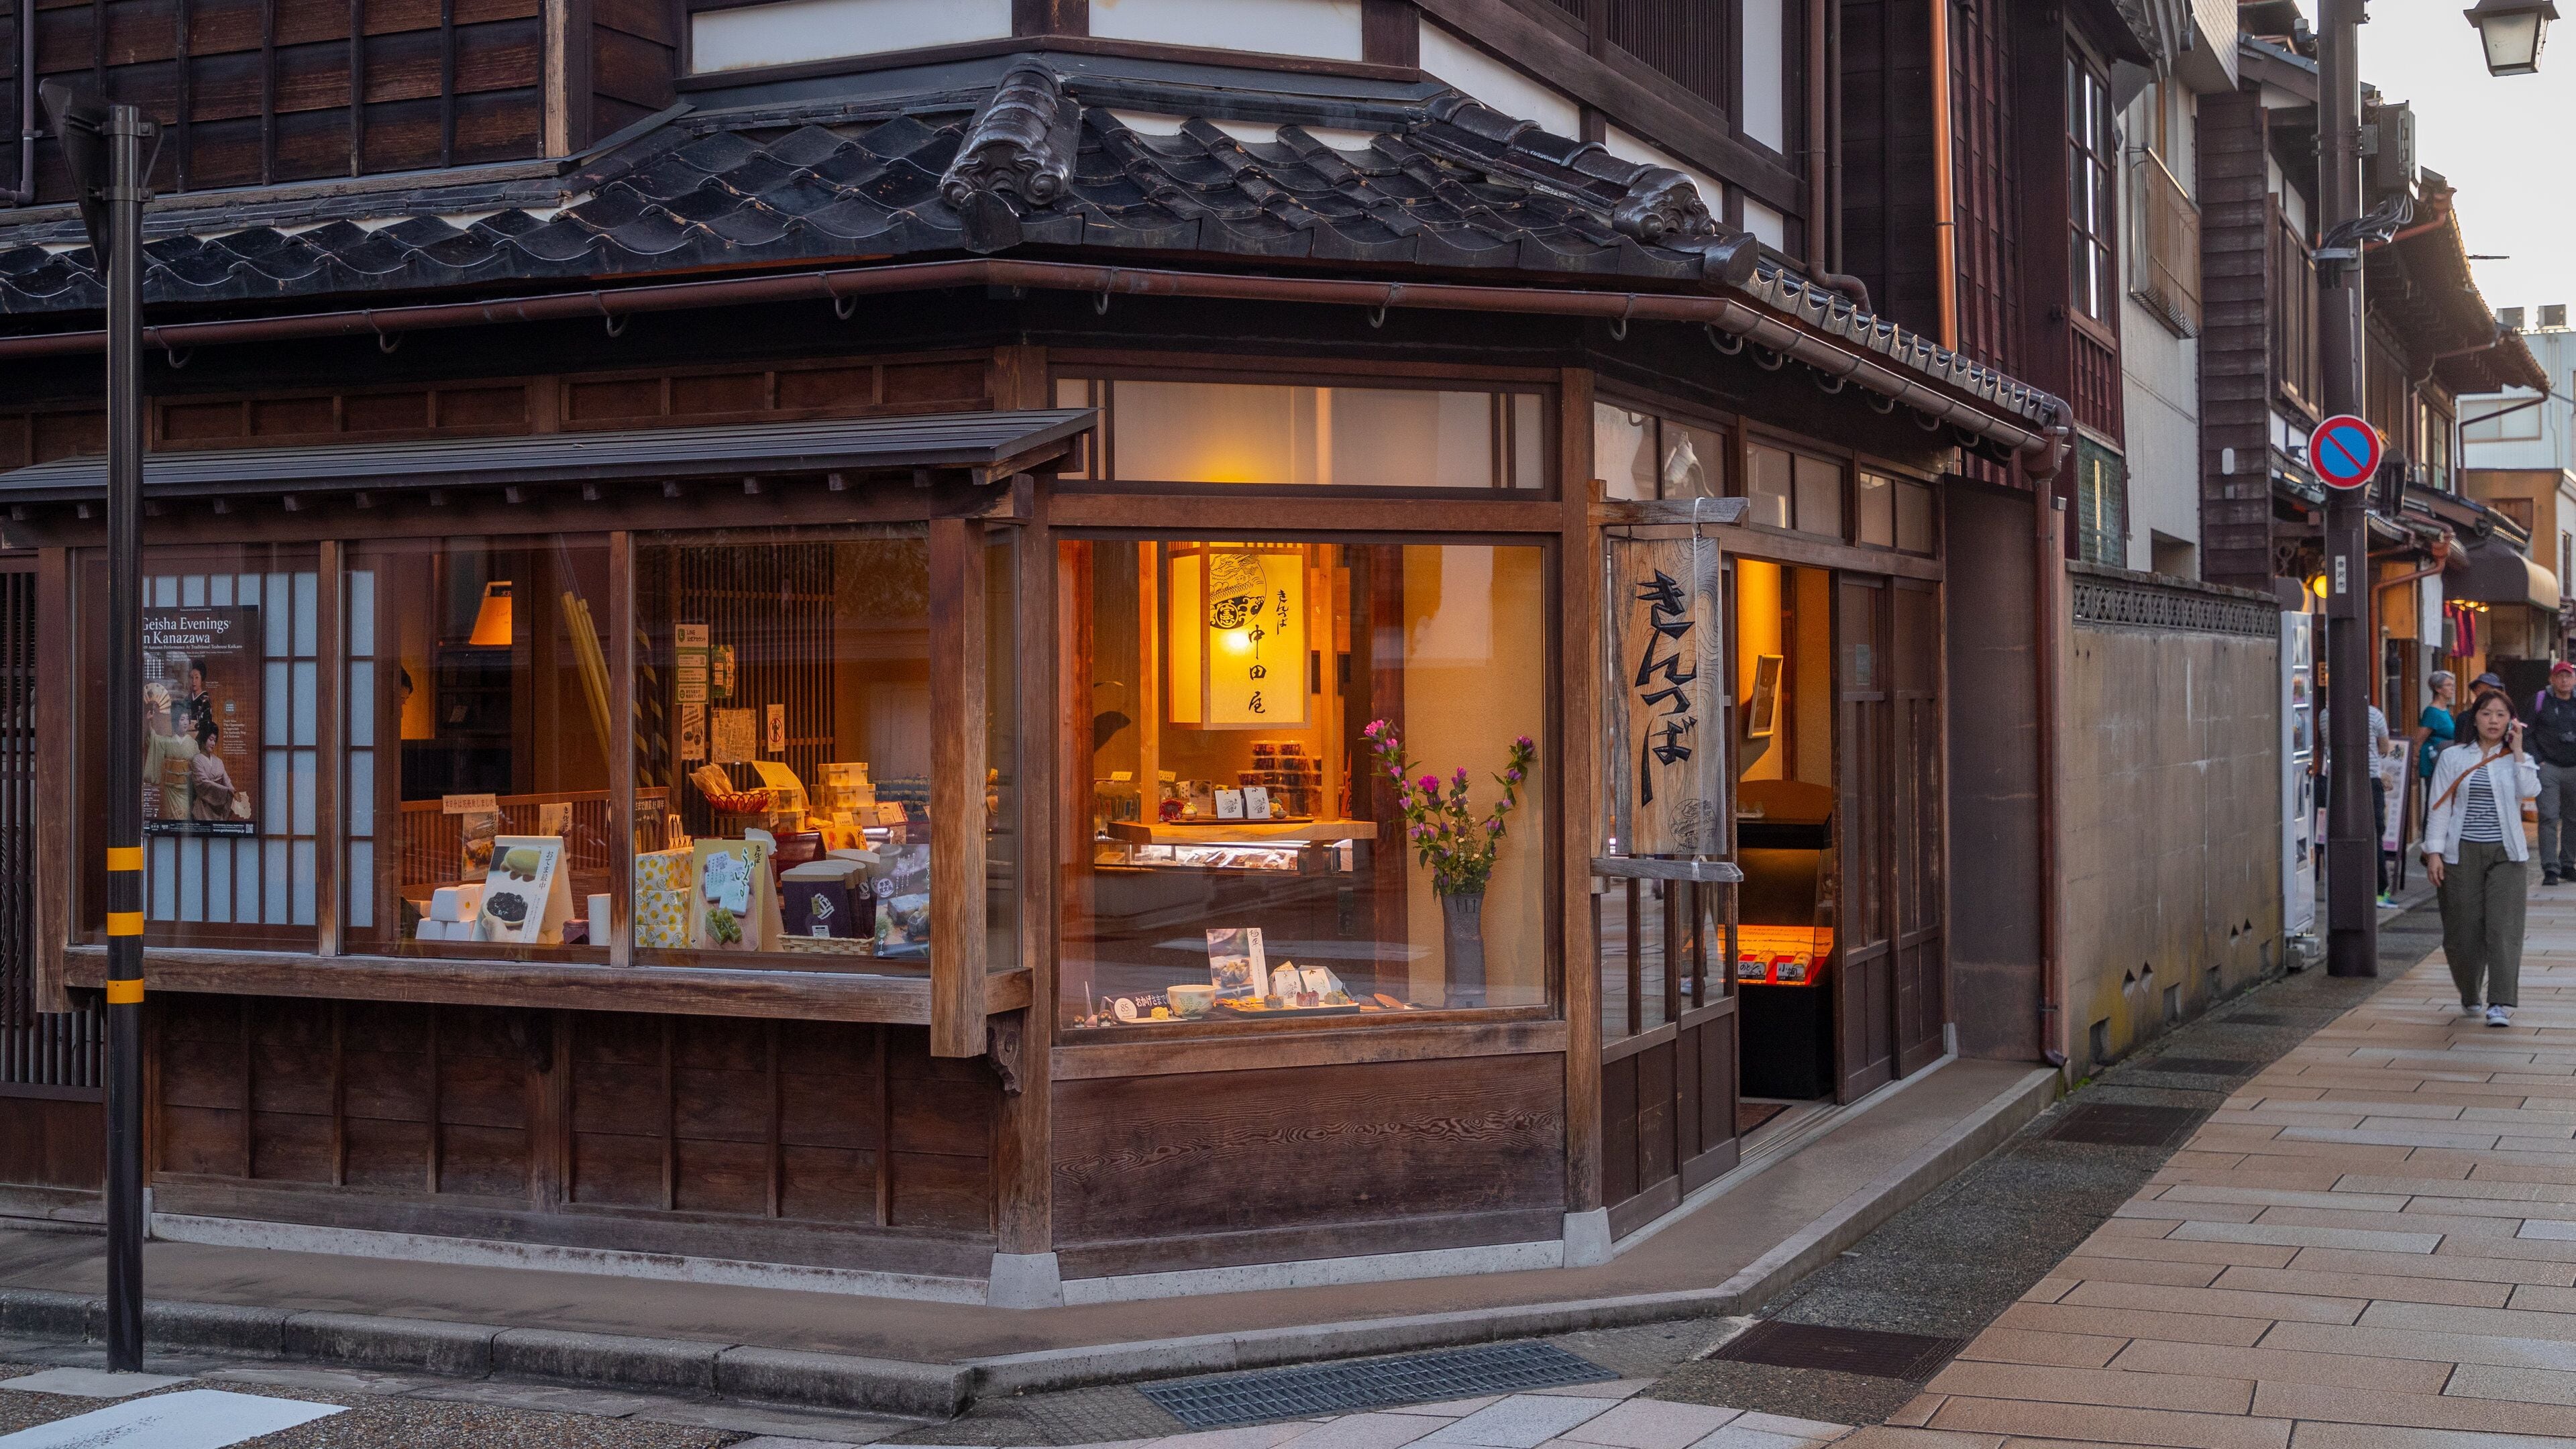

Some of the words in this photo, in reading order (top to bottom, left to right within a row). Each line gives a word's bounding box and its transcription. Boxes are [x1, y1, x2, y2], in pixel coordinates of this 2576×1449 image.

[2337, 560, 2345, 588] 金沢市
[1276, 589, 1289, 635] きんつば
[154, 631, 210, 644] Kanazawa
[1248, 624, 1267, 714] 中田屋
[1635, 568, 1697, 808] きんつば
